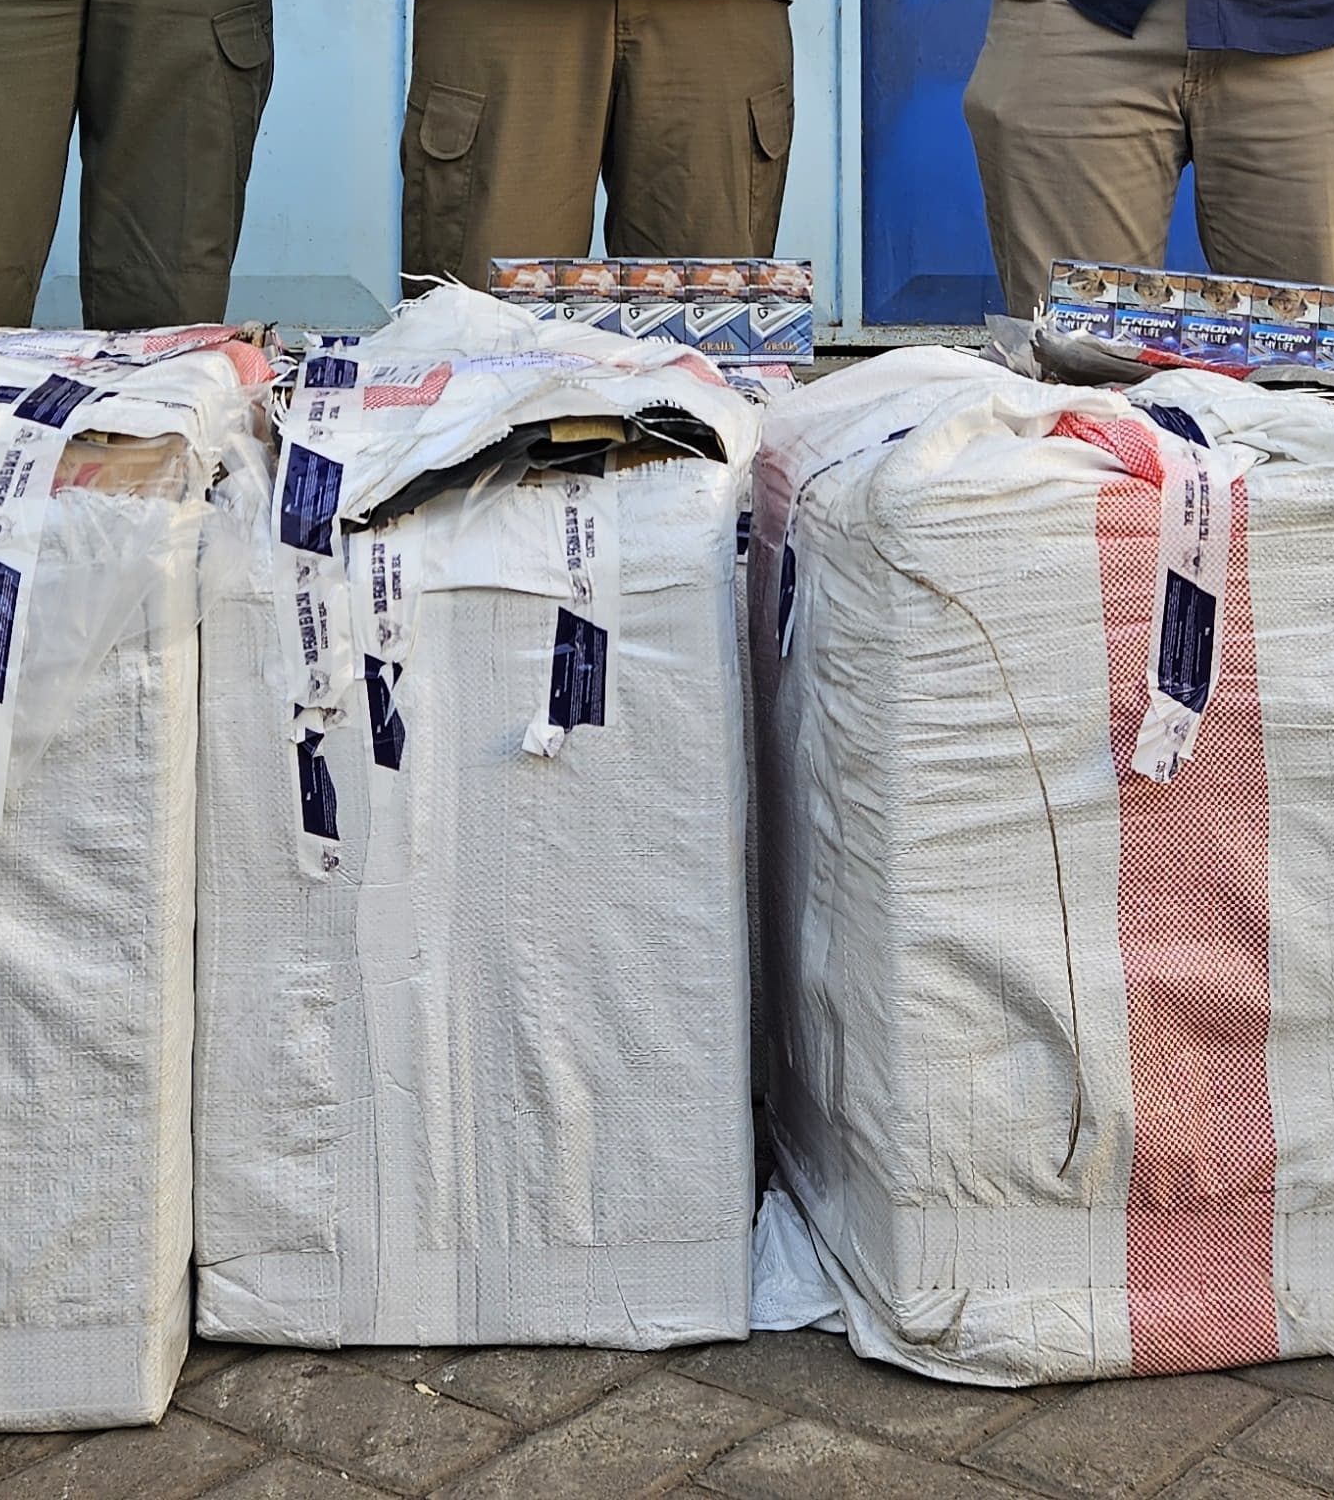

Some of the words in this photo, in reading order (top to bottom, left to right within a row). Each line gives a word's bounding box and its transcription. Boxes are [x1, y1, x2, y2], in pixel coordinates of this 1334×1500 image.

[1055, 309, 1110, 323] CROWN
[1121, 316, 1176, 329] CROWN
[1188, 322, 1243, 336] CROWN
[1255, 331, 1311, 344] CROWN
